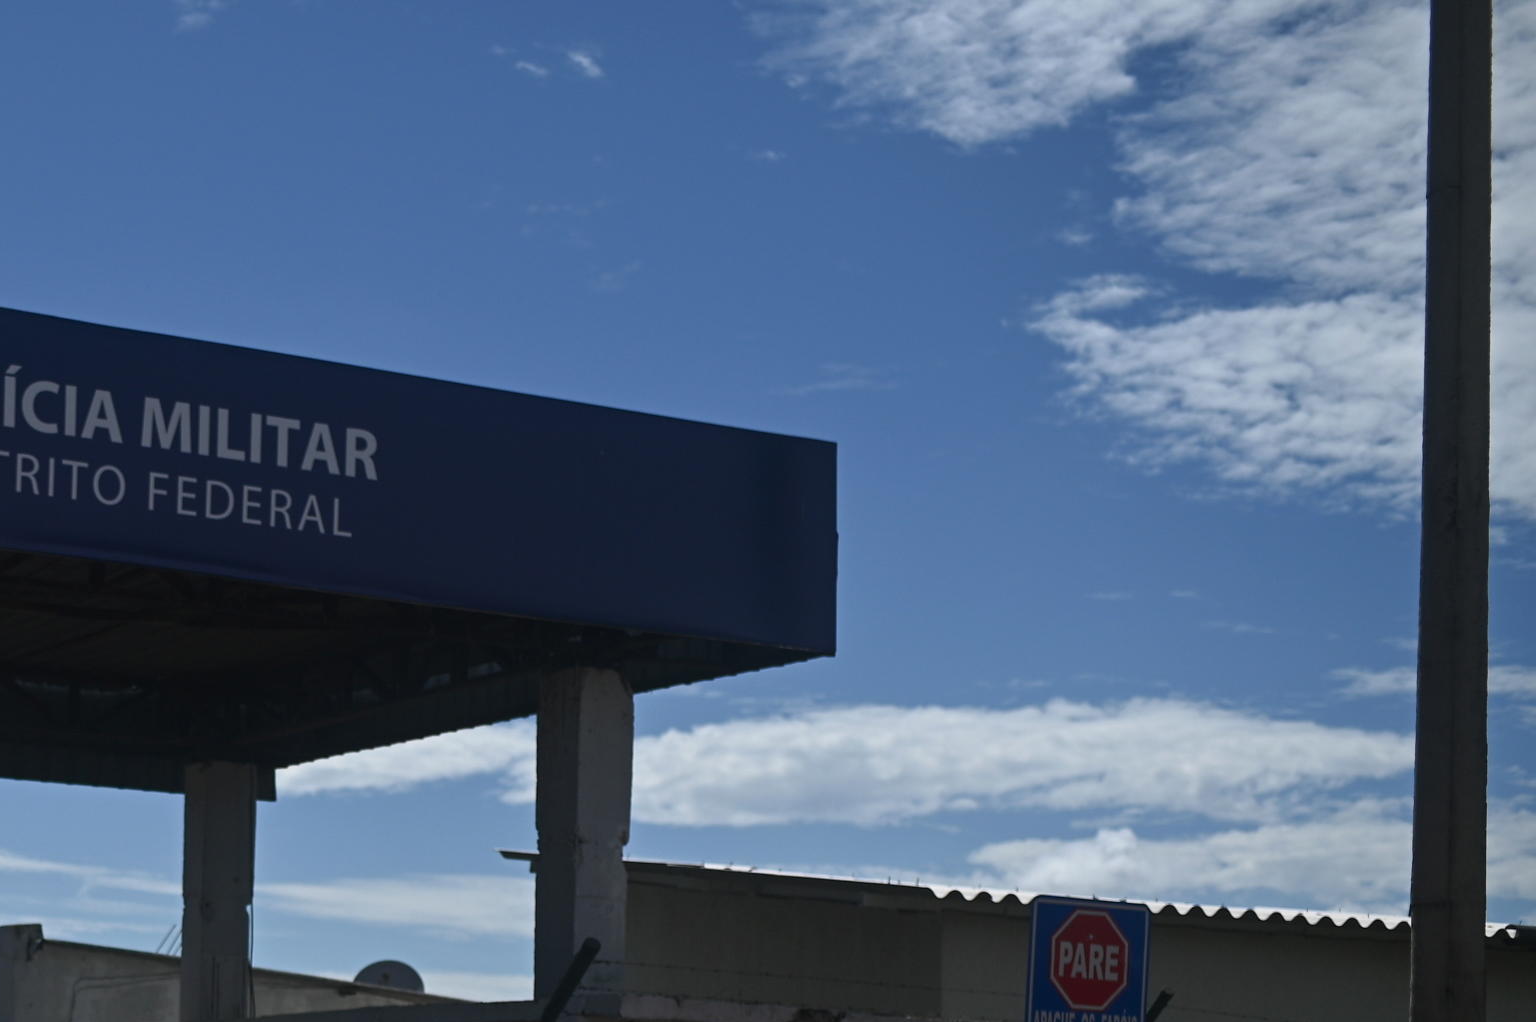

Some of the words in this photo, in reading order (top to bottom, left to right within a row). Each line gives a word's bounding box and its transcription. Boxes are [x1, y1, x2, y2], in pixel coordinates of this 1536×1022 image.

[140, 396, 379, 481] MILITAR
[147, 472, 353, 538] FEDERAL
[1058, 941, 1120, 981] PARE
